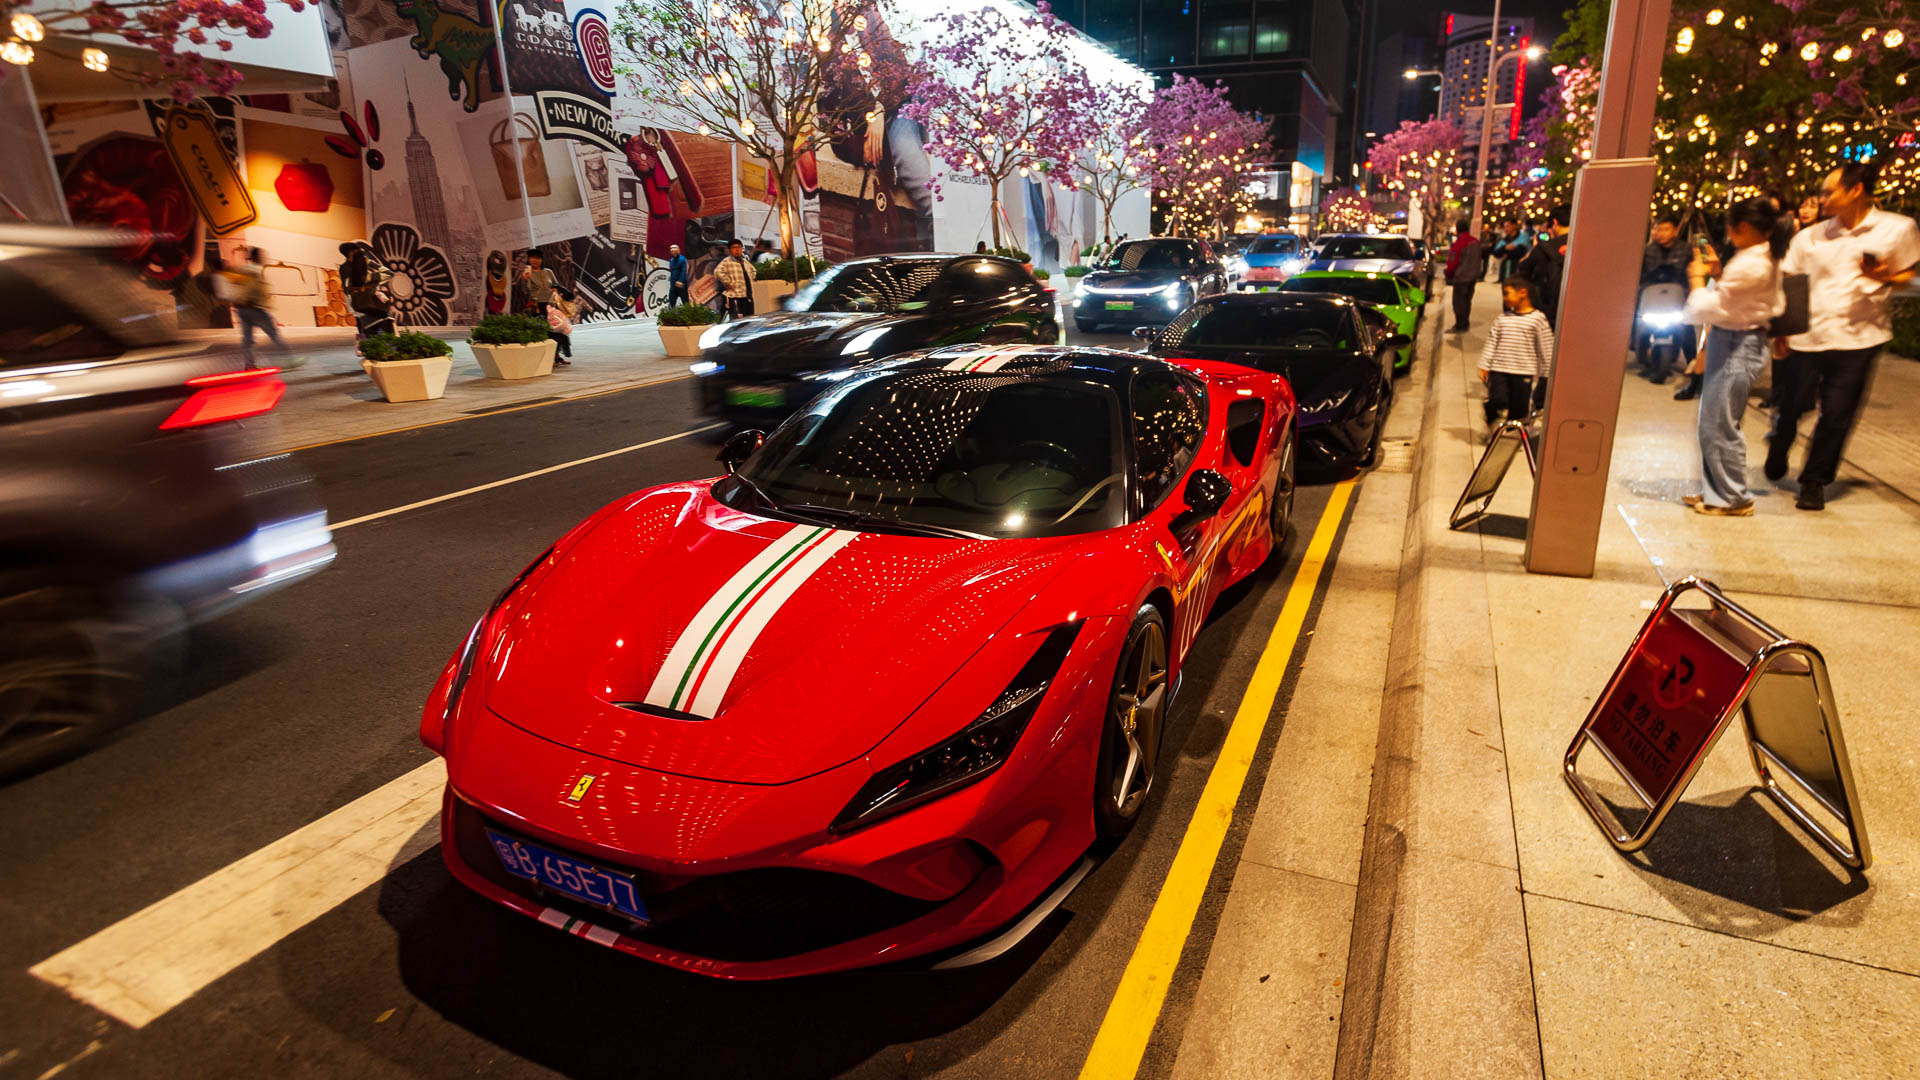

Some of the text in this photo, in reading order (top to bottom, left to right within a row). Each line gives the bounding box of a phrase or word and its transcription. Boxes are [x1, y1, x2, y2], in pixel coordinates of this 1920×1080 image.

[514, 32, 578, 52] COACH
[553, 102, 623, 146] NEW YORK
[191, 143, 229, 206] COACH
[1621, 727, 1667, 779] PARKING
